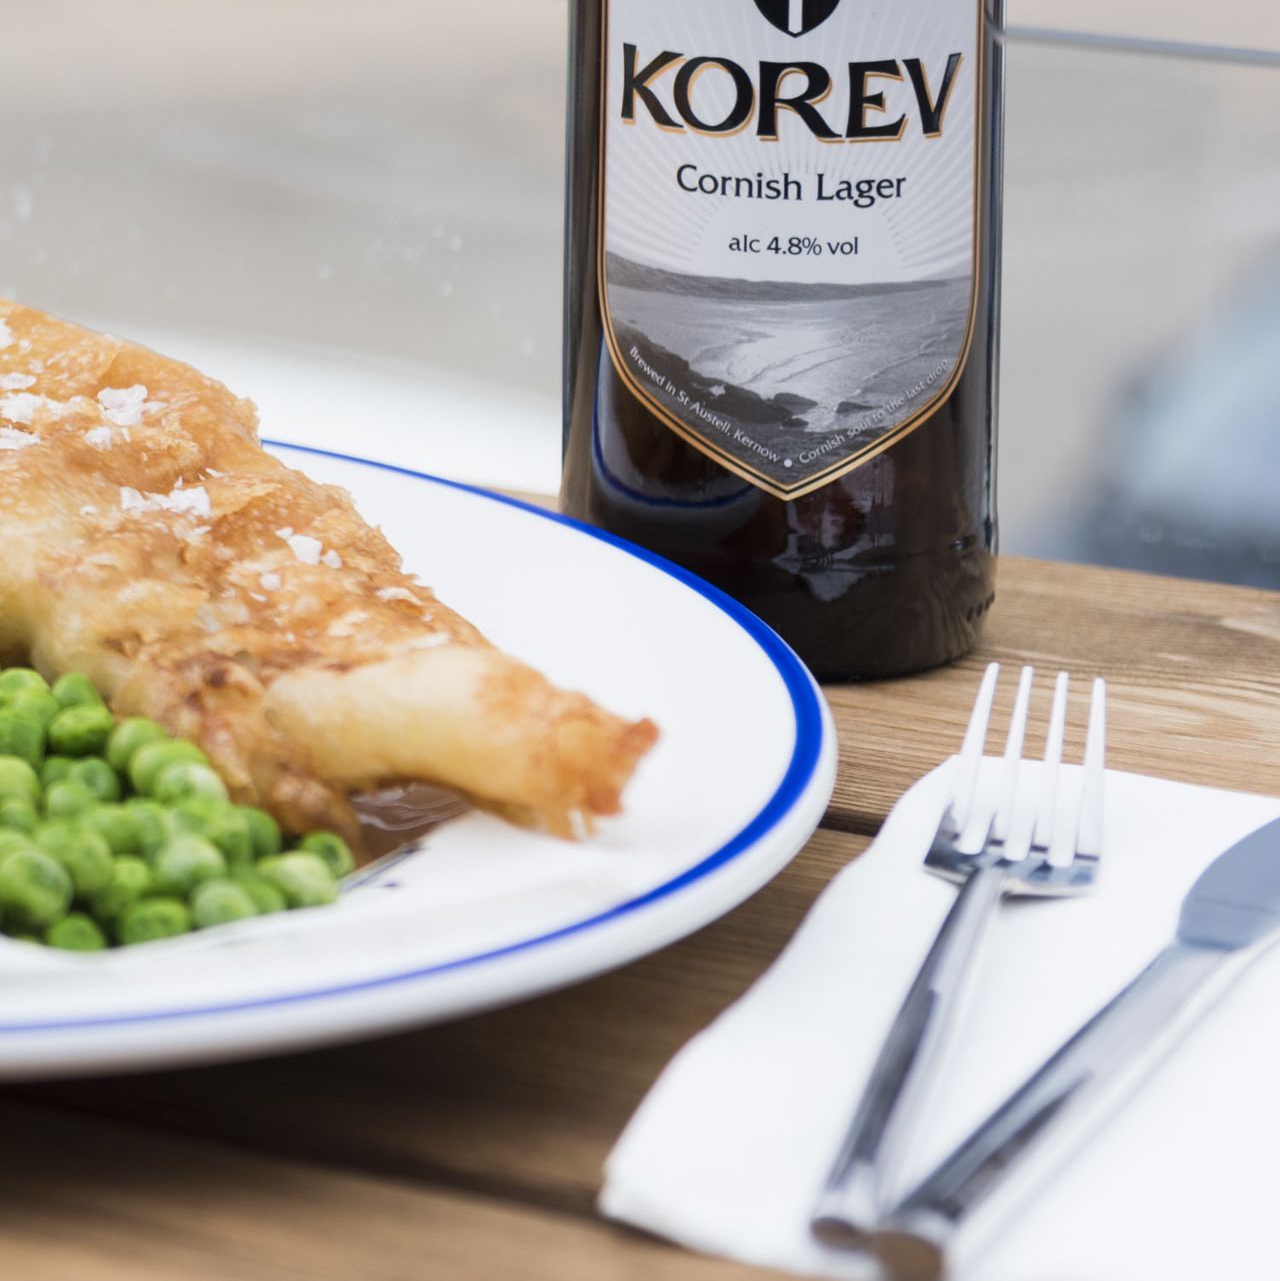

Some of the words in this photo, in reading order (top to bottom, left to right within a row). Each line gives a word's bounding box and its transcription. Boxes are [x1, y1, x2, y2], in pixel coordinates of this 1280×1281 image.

[621, 42, 963, 144] KOREV
[676, 164, 803, 201] Cornish
[816, 174, 906, 209] Lager
[728, 234, 761, 253] alc
[766, 236, 822, 256] 4.8%
[827, 236, 859, 255] vol
[629, 345, 666, 386] Brewed
[665, 380, 677, 396] in
[676, 389, 690, 406] St
[690, 401, 732, 437] Austell,
[733, 427, 781, 463] Kernow
[798, 433, 845, 464] Cornish
[846, 419, 871, 440] soul
[872, 409, 885, 423] to
[885, 397, 905, 416] the
[905, 380, 926, 401] last
[926, 358, 949, 385] drop
